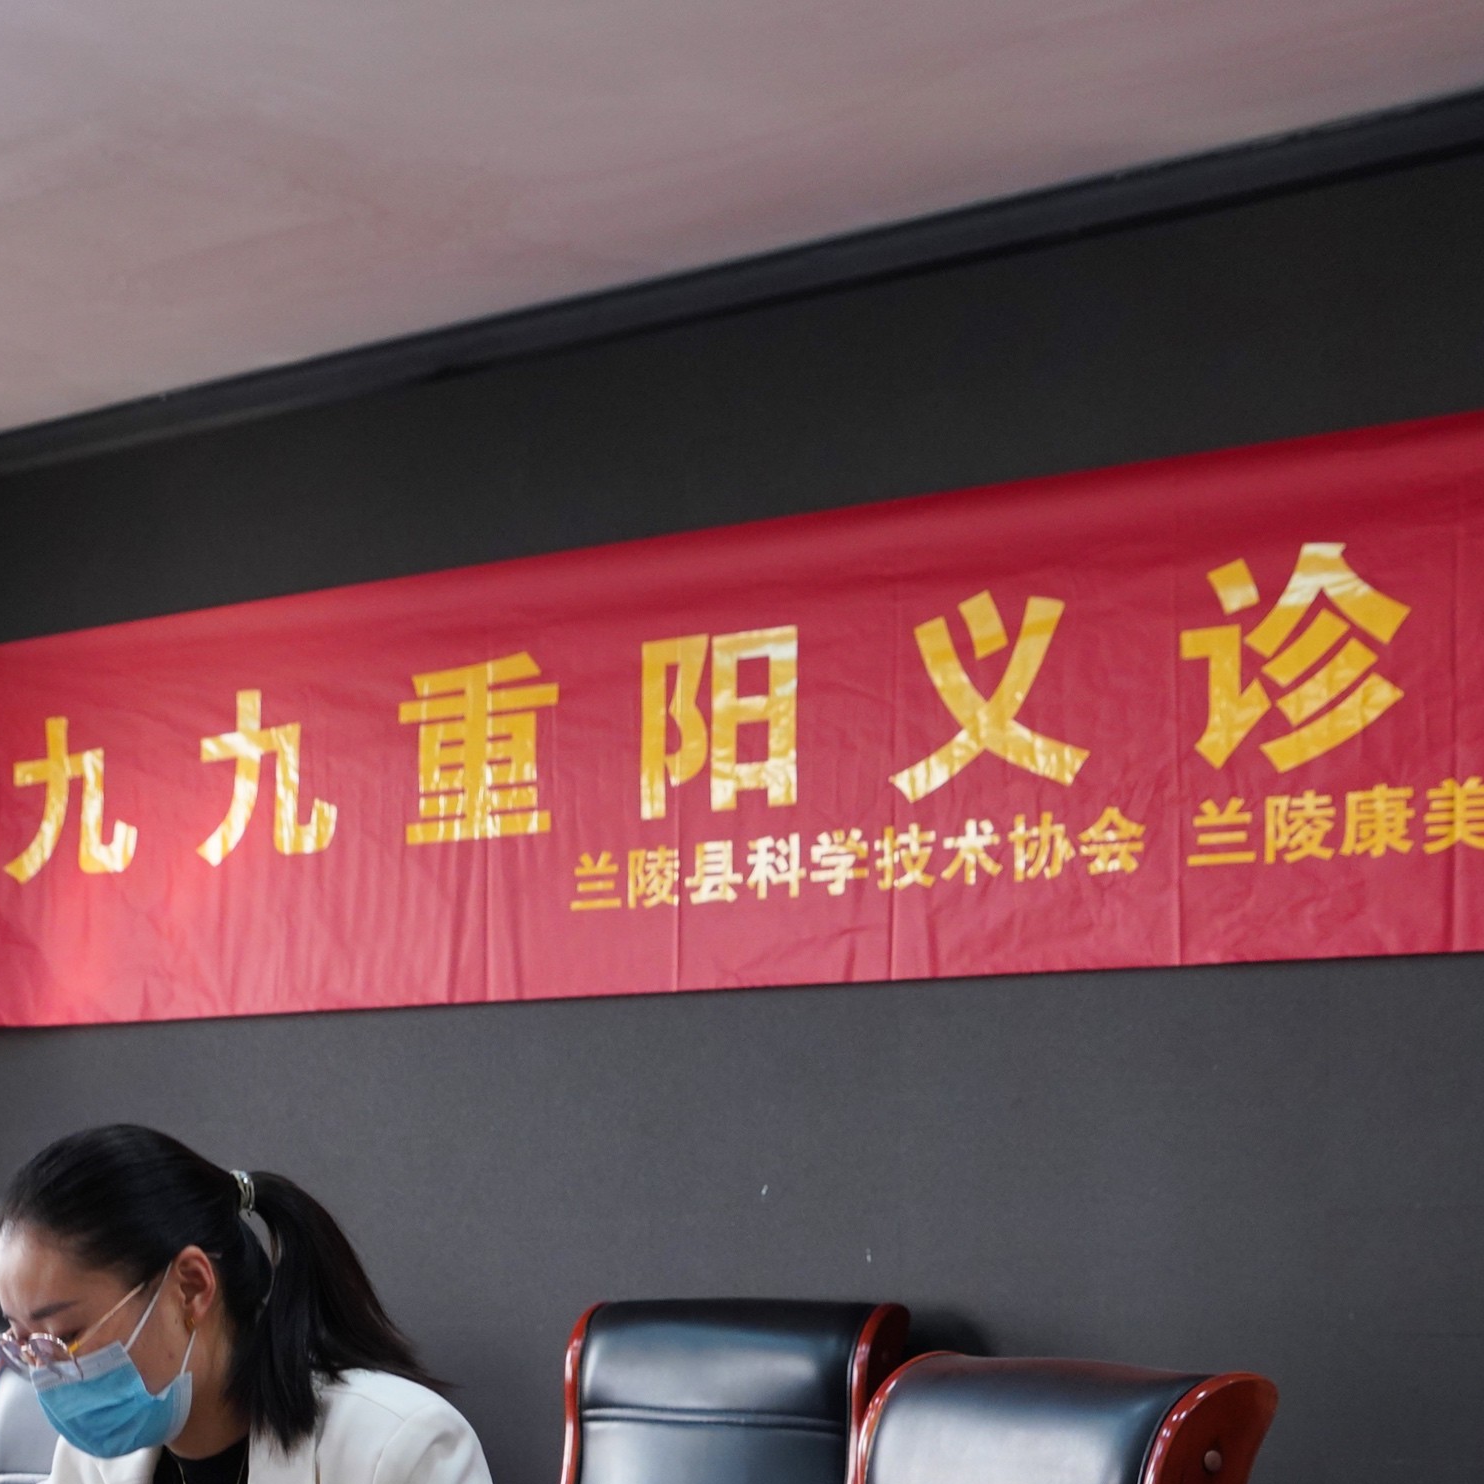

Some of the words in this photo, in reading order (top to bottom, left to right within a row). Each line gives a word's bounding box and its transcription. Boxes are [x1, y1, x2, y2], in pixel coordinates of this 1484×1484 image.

[569, 806, 1146, 912] 兰陵县科学技术协会
